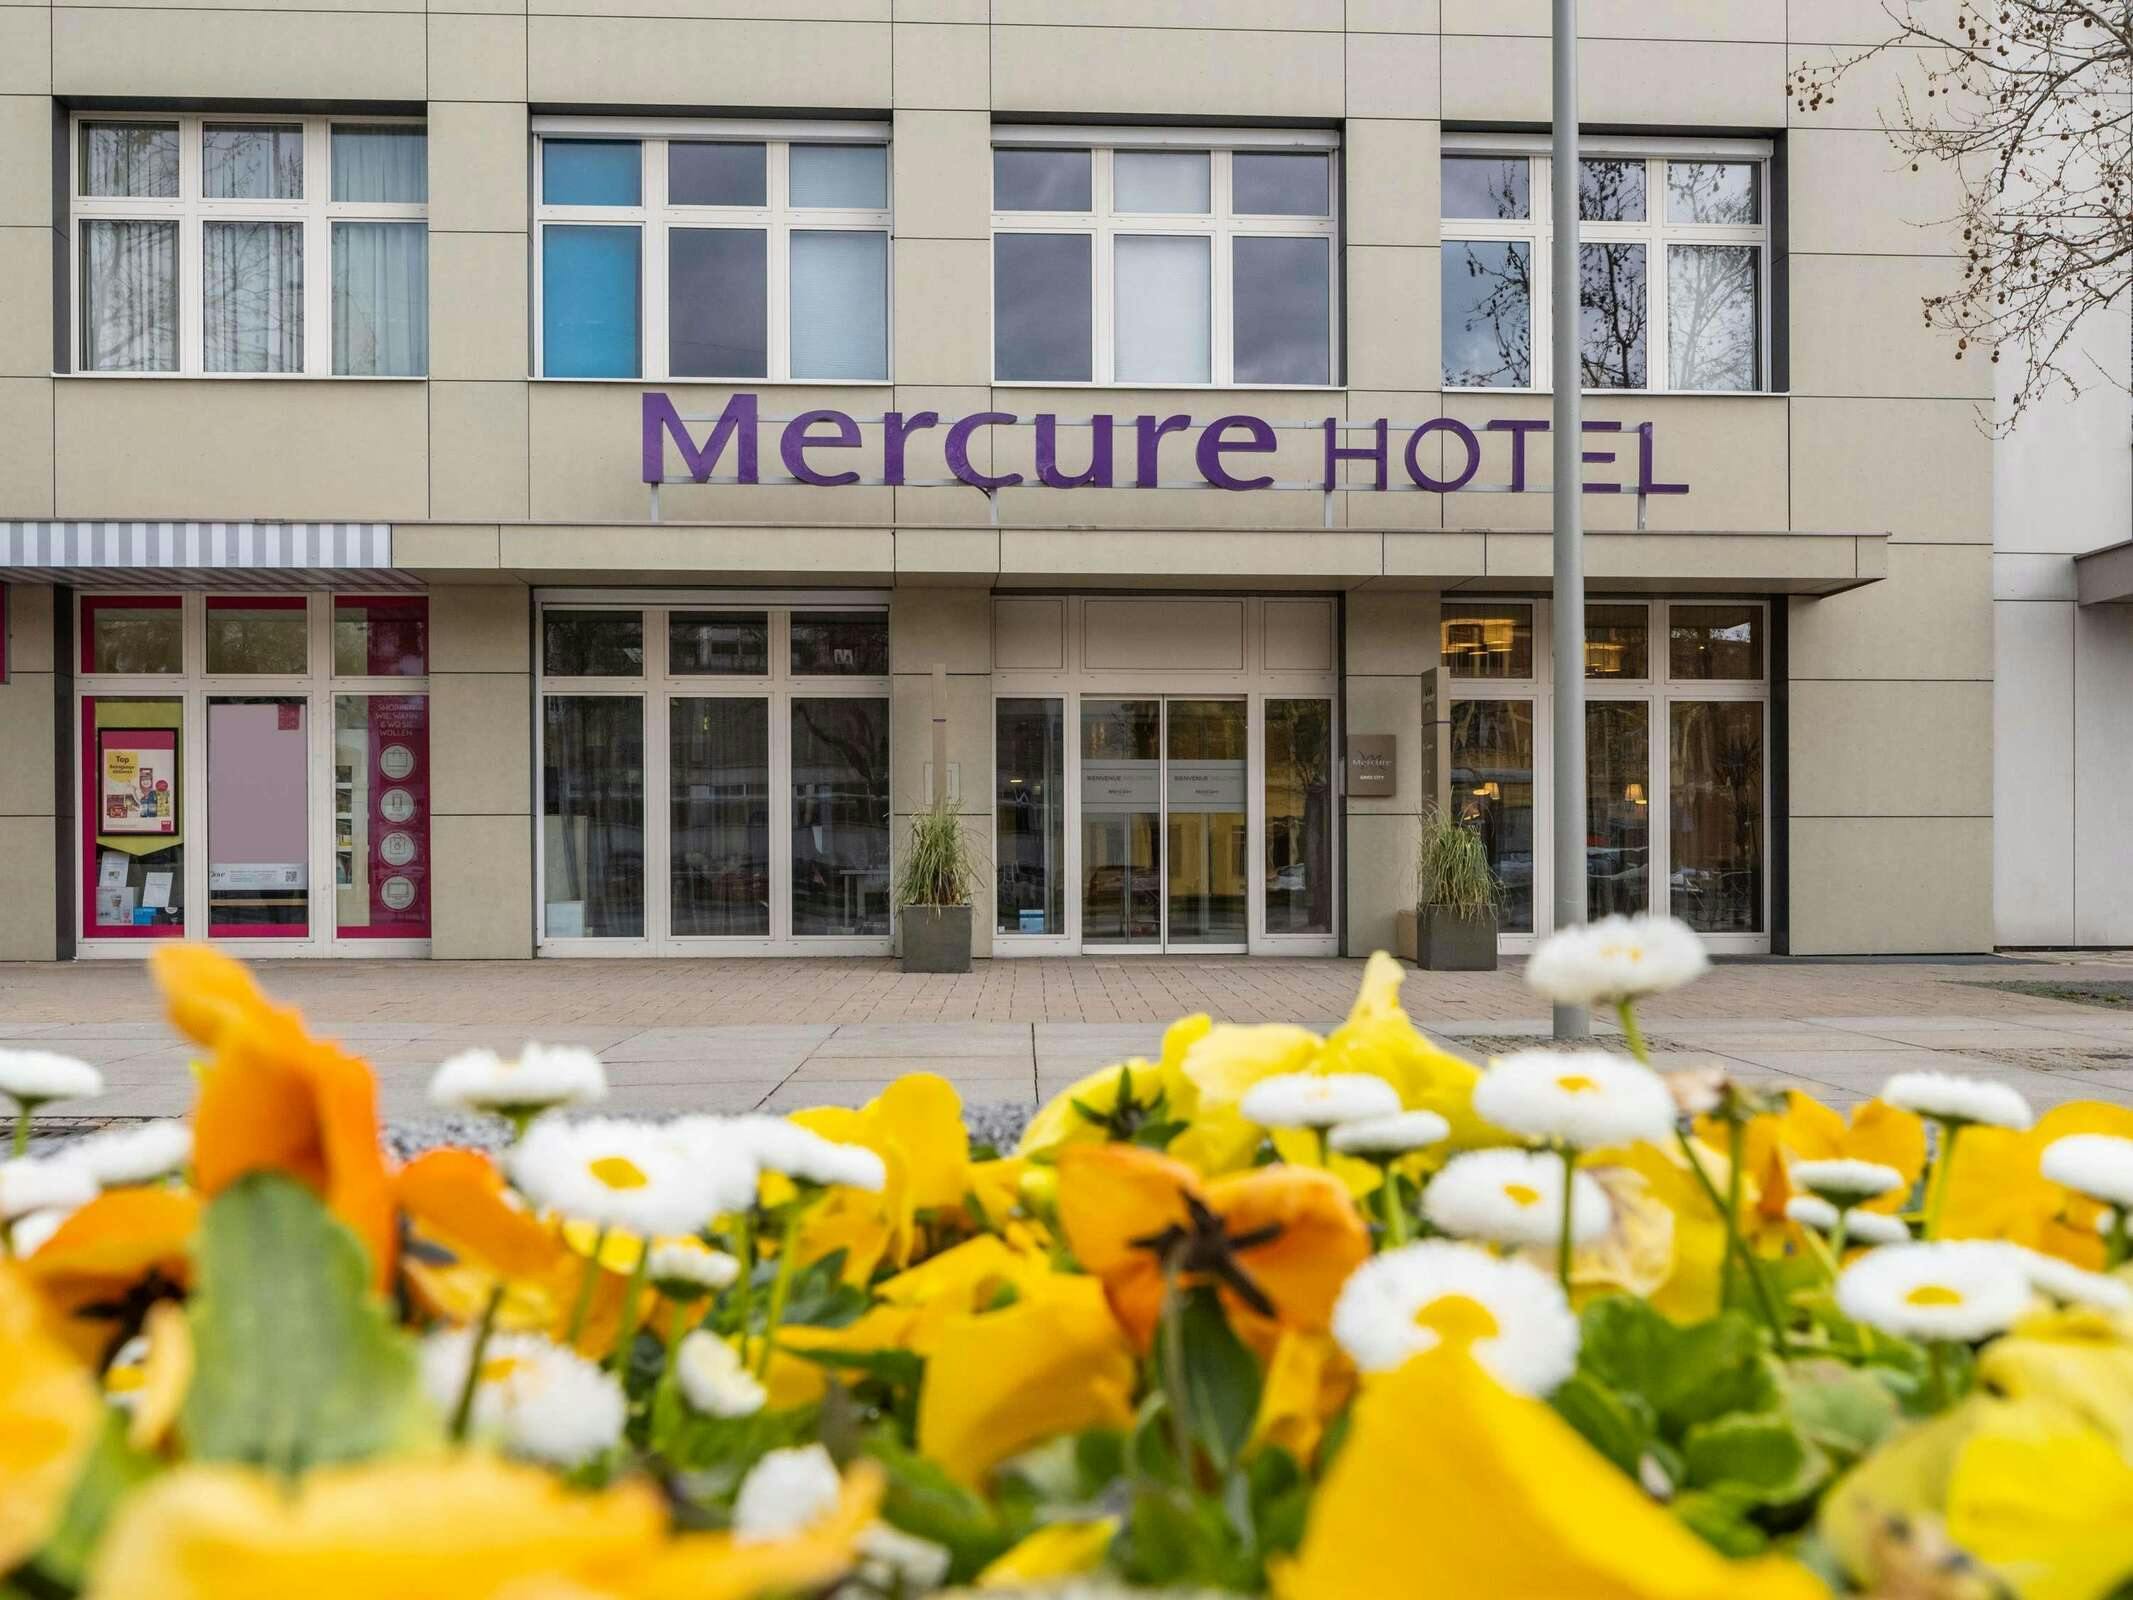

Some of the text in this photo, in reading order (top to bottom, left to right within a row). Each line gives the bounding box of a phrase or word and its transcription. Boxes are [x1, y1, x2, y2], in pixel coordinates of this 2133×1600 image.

[642, 392, 1690, 494] Mercure HOTEL
[115, 755, 130, 764] Top
